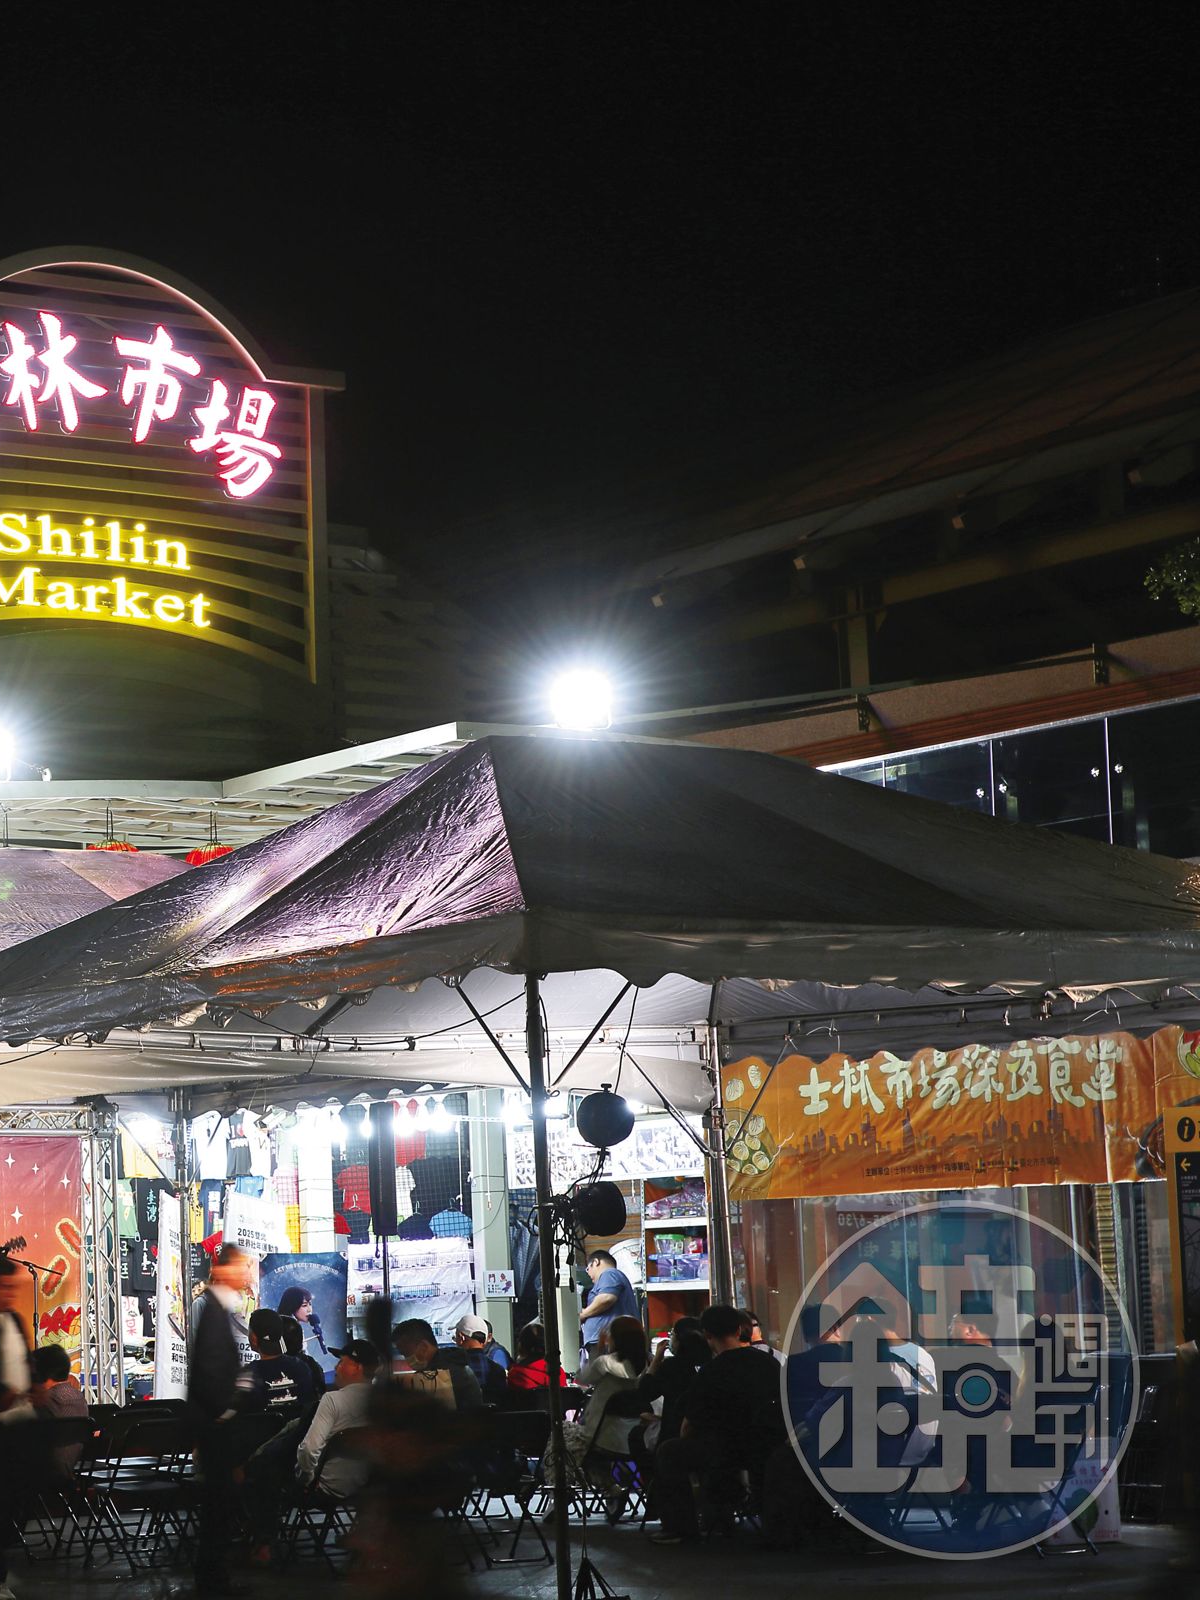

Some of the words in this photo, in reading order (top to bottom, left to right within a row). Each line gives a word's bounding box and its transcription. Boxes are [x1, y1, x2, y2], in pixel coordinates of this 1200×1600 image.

[799, 1037, 1122, 1115] 士林市場深夜食堂
